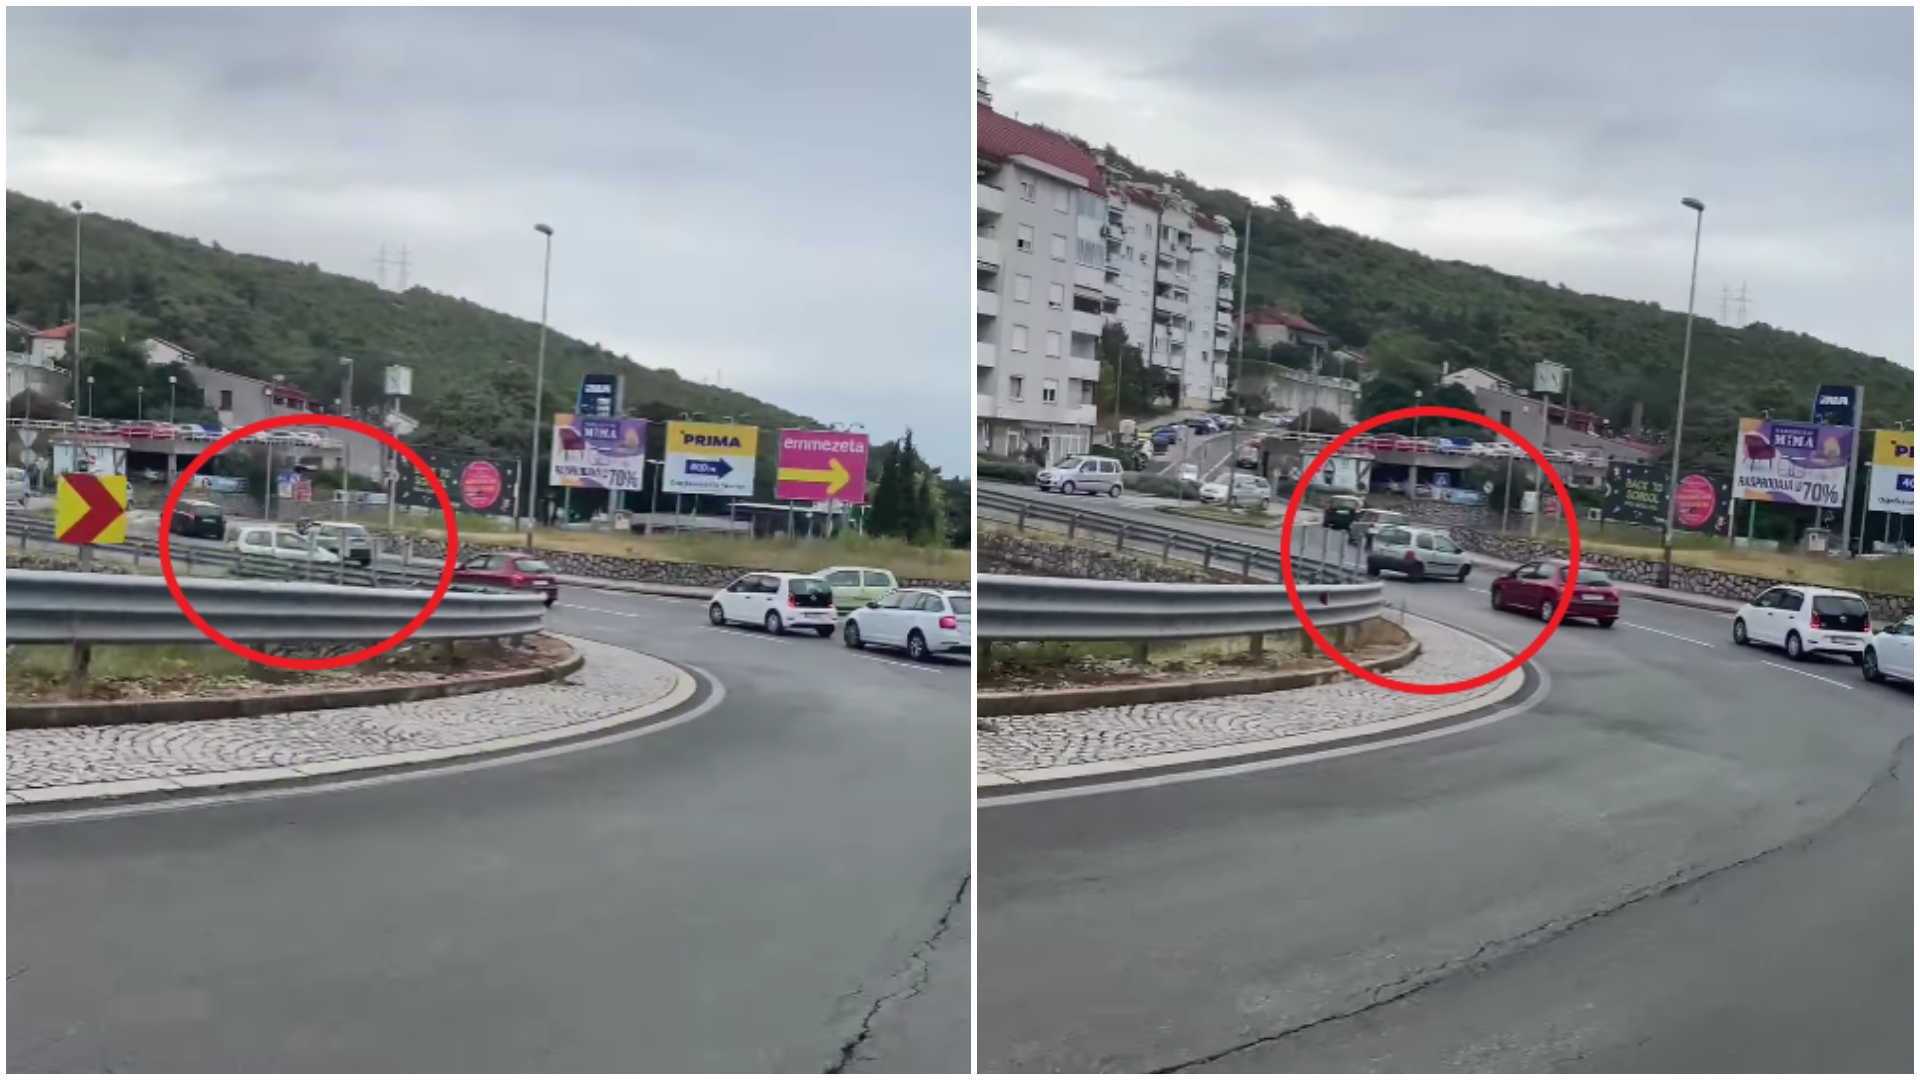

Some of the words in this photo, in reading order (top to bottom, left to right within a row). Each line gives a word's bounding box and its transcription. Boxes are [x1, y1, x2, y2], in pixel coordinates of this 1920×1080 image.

[683, 433, 741, 449] PRIMA
[784, 437, 865, 453] emmezeta
[1625, 478, 1649, 491] BACK
[1803, 481, 1838, 504] 70%
[1625, 489, 1659, 504] SCHOOL
